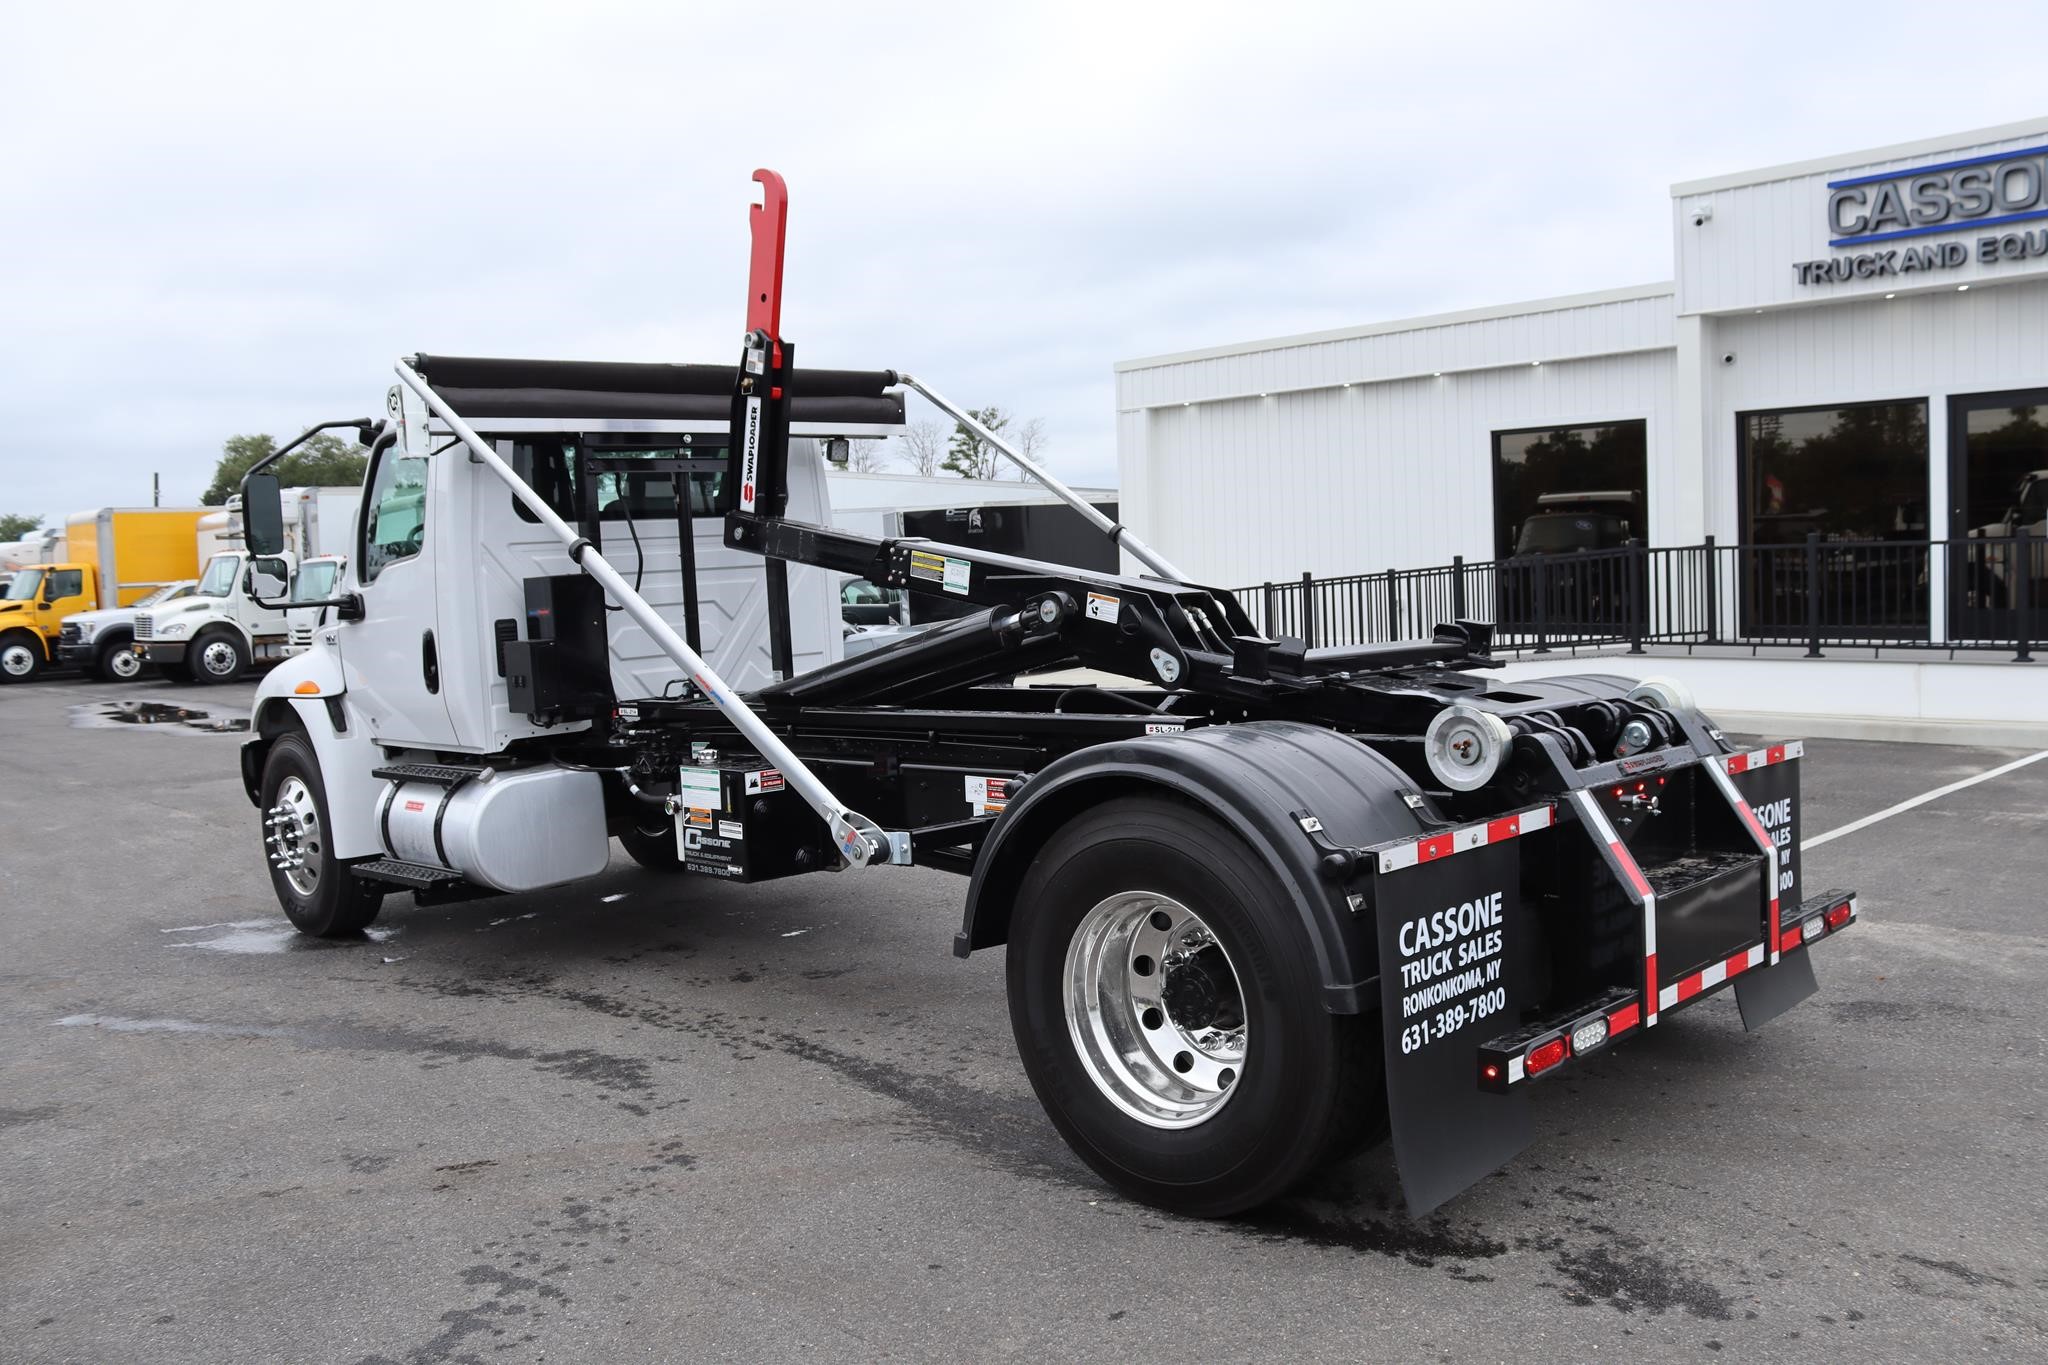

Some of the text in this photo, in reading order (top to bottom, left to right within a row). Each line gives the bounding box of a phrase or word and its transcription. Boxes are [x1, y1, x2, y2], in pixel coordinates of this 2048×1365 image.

[1828, 157, 2048, 236] CASSO
[1793, 250, 1898, 285] TRUCK
[1899, 242, 1968, 273] AND
[746, 406, 758, 482] SWAPLOADER
[1781, 849, 1791, 866] NY
[1399, 892, 1503, 957] CASSONE
[1401, 930, 1502, 988] TRUCK SALES
[1403, 959, 1501, 1018] RONKONKOMA, NY
[1402, 987, 1505, 1054] 631-389-7800
